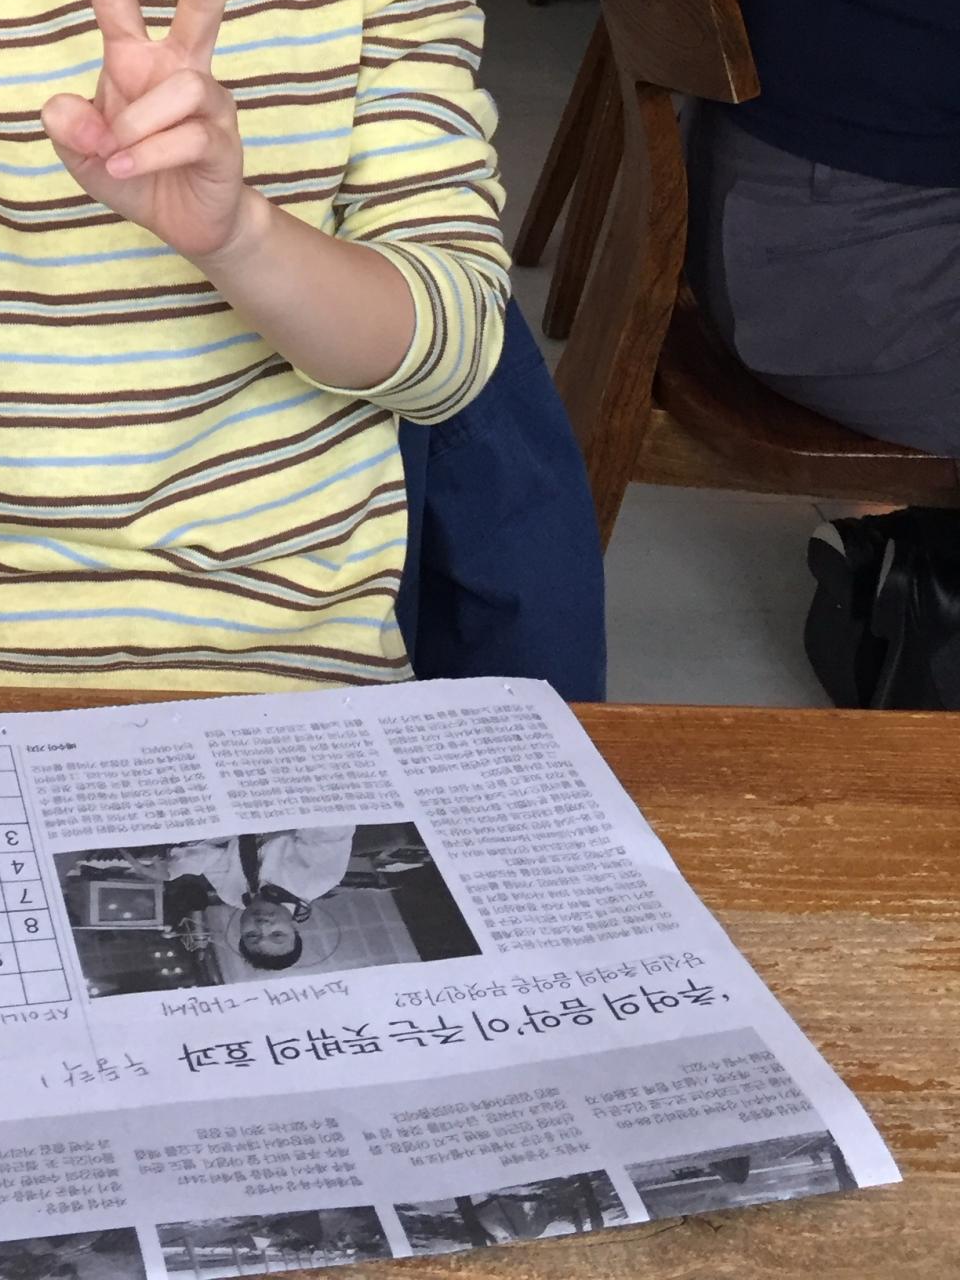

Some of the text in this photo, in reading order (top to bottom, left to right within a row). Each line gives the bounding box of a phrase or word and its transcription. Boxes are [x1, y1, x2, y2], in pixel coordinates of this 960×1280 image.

[27, 744, 45, 752] 기자
[5, 831, 19, 846] 3
[10, 860, 24, 875] 4
[19, 888, 33, 904] 7
[24, 918, 39, 934] 8
[393, 952, 705, 1007] 당신의 추억의 음악은 무엇인가요?
[264, 980, 349, 1005] 소녀시대
[161, 997, 239, 1016] 다만세
[0, 1008, 69, 1023] 샤이니
[388, 1016, 465, 1047] 주는
[265, 1023, 381, 1065] 뜻밖의
[178, 1040, 255, 1072] 효과
